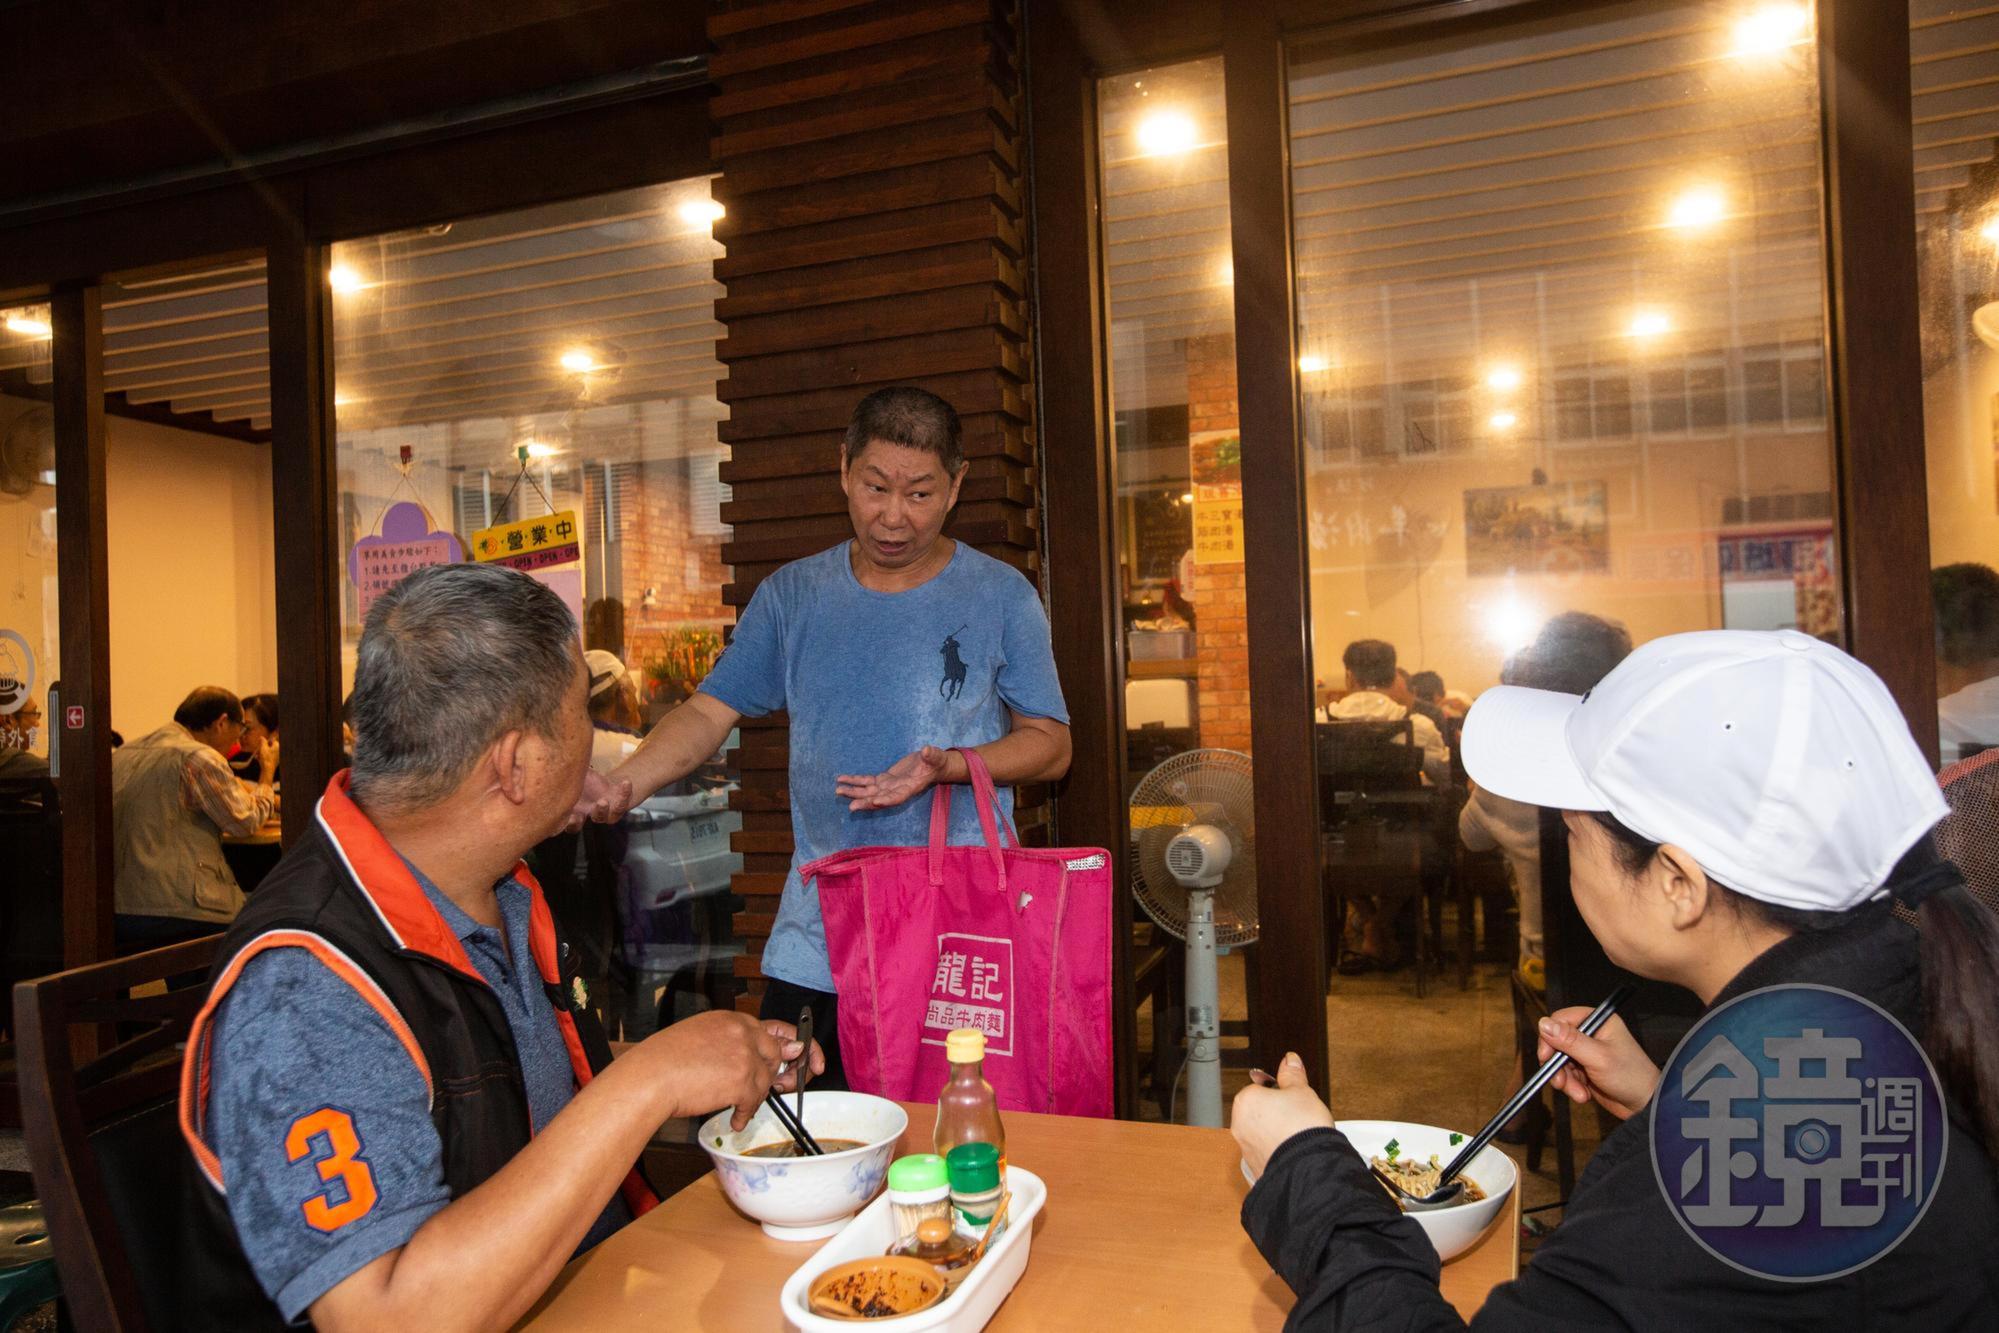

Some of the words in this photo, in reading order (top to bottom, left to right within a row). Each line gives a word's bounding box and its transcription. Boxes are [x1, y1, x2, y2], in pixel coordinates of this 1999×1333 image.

[932, 951, 1003, 1001] 龍記
[928, 1004, 1001, 1033] 尚品牛肉麵
[284, 1103, 382, 1236] 3
